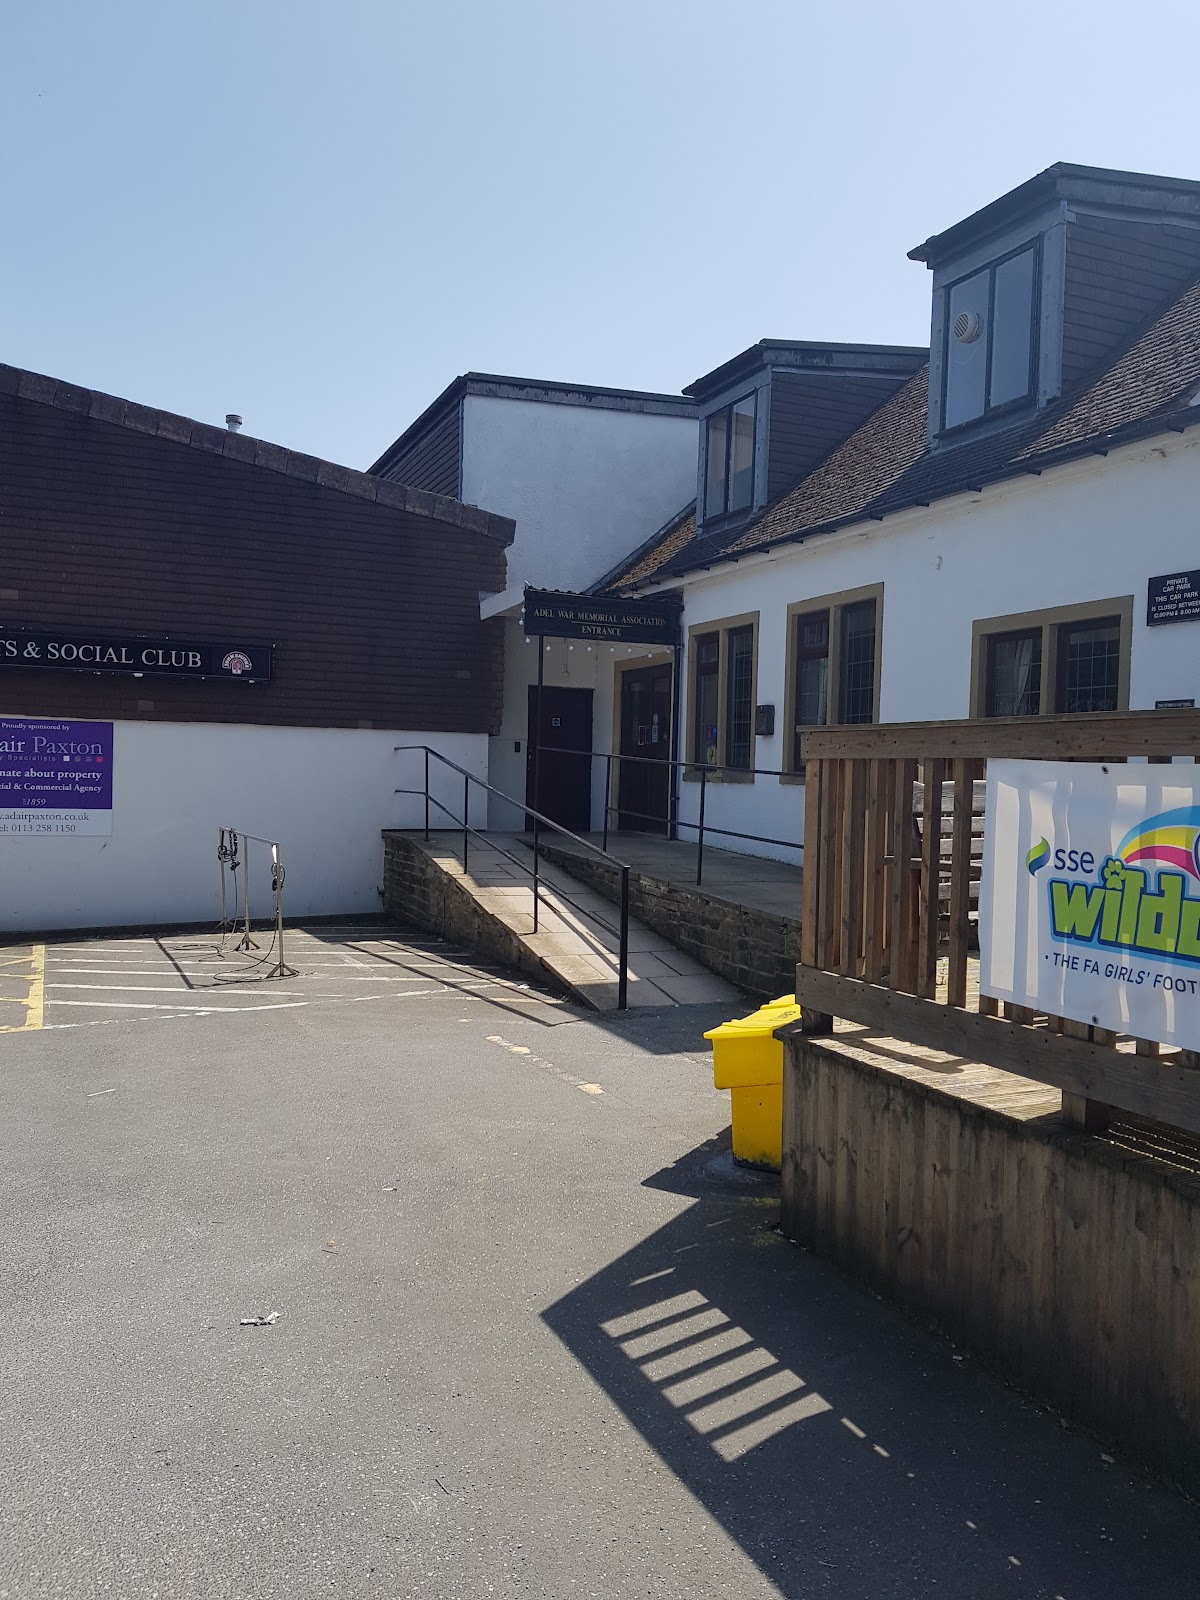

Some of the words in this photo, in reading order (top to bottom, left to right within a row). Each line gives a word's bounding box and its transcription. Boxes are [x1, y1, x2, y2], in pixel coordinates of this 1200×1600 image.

[1166, 577, 1188, 586] PRIVATE
[534, 608, 555, 618] ADEL
[557, 609, 575, 619] WAR
[577, 612, 618, 623] MEMORIAL
[621, 616, 667, 627] ASSOCIATION
[581, 625, 622, 636] ENTRANCE
[23, 641, 42, 658] &
[47, 642, 134, 664] SOCIAL
[141, 648, 202, 668] CLUB
[32, 736, 103, 754] Paxton
[24, 768, 55, 778] about
[57, 771, 103, 781] property
[23, 782, 72, 791] Commercial
[74, 784, 102, 793] Agency
[26, 798, 47, 806] 1859
[11, 824, 33, 832] 0113
[35, 824, 52, 832] 258
[55, 824, 76, 832] 1150
[1054, 848, 1095, 873] sse
[1053, 952, 1079, 970] THE
[1083, 958, 1100, 976] FA
[1104, 963, 1150, 985] GIRLS'
[1153, 973, 1200, 995] FOOT
